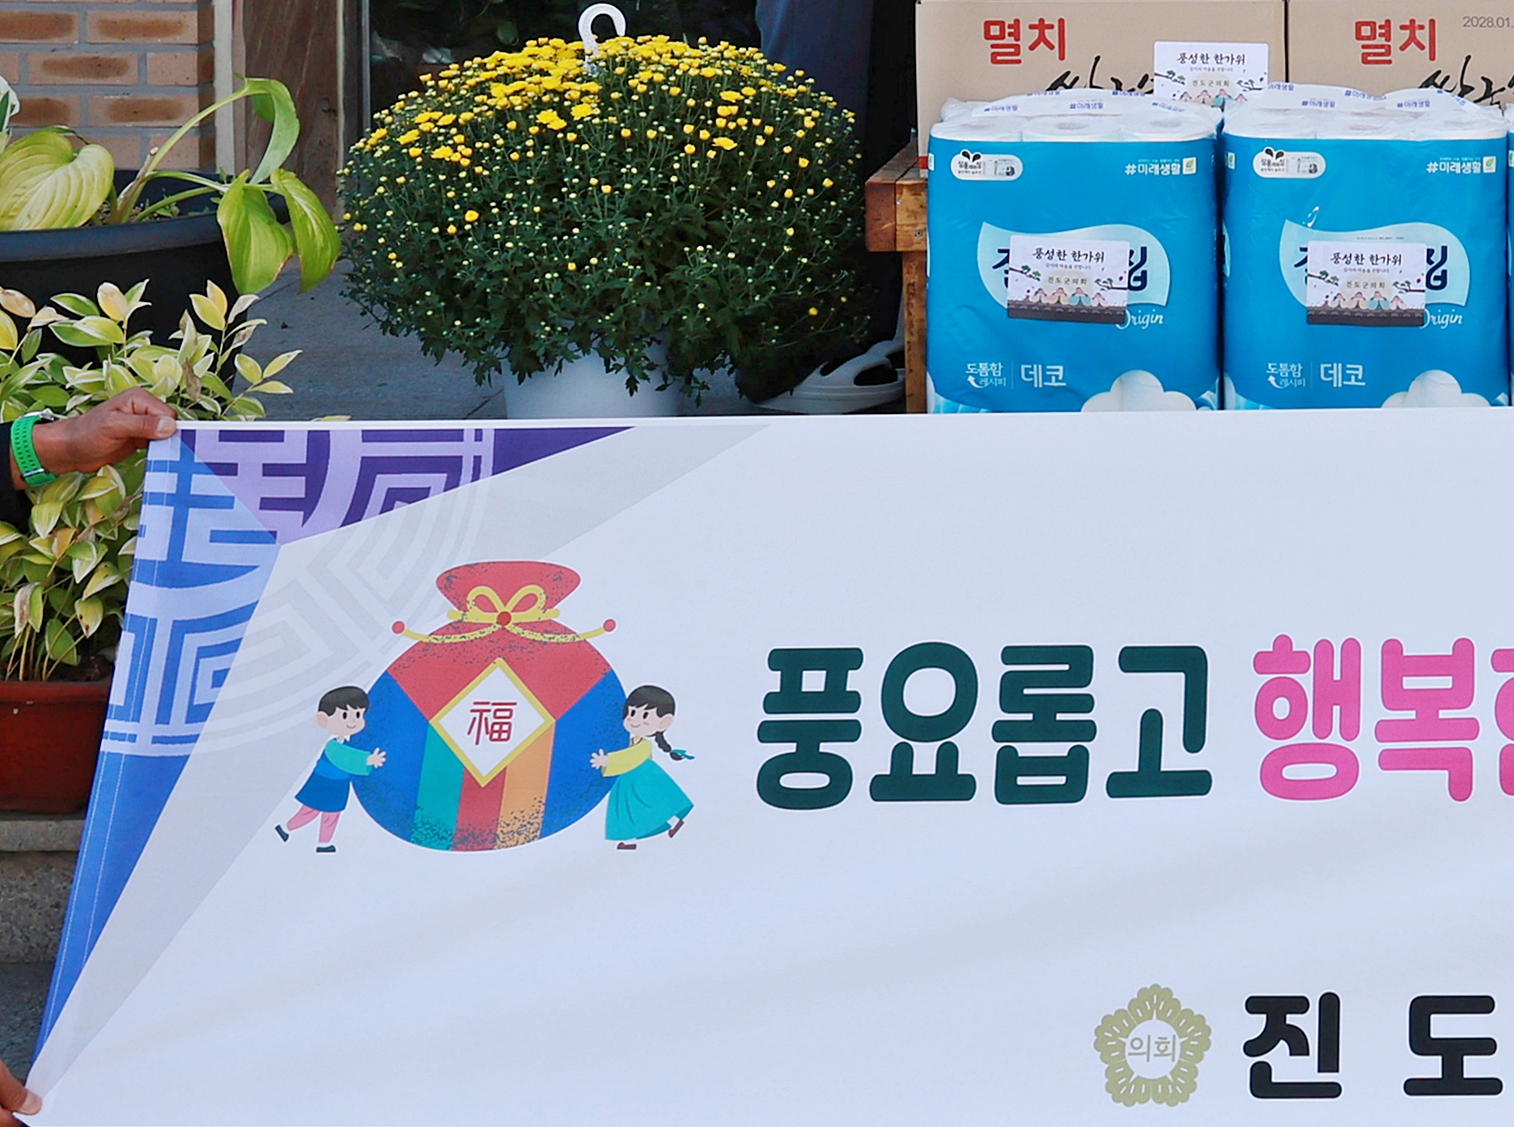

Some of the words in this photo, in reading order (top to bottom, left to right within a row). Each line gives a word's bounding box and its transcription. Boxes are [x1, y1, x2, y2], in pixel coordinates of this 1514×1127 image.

[983, 17, 1065, 65] 멸치
[1354, 17, 1437, 65] 멸치
[1177, 52, 1210, 65] 풍성한
[1213, 53, 1246, 65] 한가위
[1125, 163, 1181, 176] #미래생활
[1426, 159, 1482, 174] #미래생활
[1032, 247, 1068, 261] 풍성한
[1071, 250, 1105, 264] 한가위
[1330, 252, 1365, 266] 풍성한
[1369, 253, 1402, 267] 한가위
[966, 362, 1003, 376] 도톰함
[1021, 364, 1067, 388] 데코
[979, 377, 1006, 387] 레시피
[1266, 362, 1303, 377] 도톰함
[1320, 363, 1366, 388] 데코
[1279, 377, 1306, 388] 레시피
[466, 701, 518, 746] 福
[756, 641, 1213, 811] 풍요롭고
[1127, 1034, 1178, 1064] 의회
